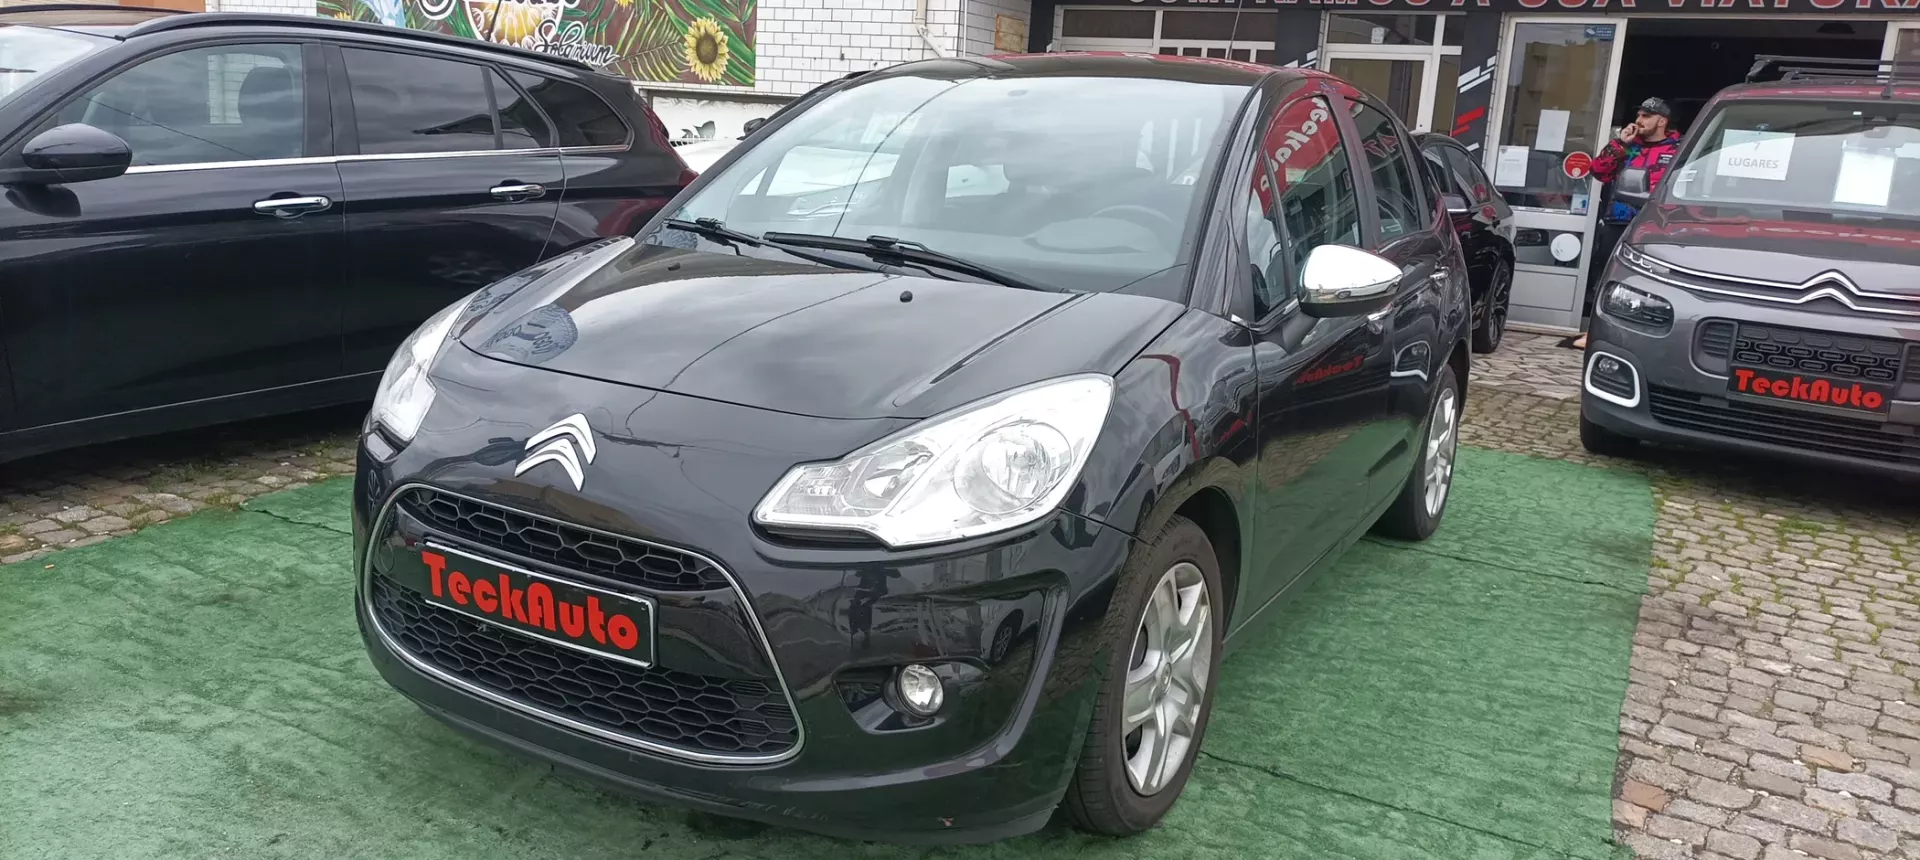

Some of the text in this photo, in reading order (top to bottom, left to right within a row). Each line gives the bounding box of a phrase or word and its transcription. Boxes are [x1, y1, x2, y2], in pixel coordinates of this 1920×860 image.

[533, 18, 618, 64] Solarium
[1728, 157, 1780, 169] LUGARES
[1753, 141, 1761, 151] 7
[1735, 368, 1883, 409] TeckAuto
[421, 551, 638, 650] TeckAuto
